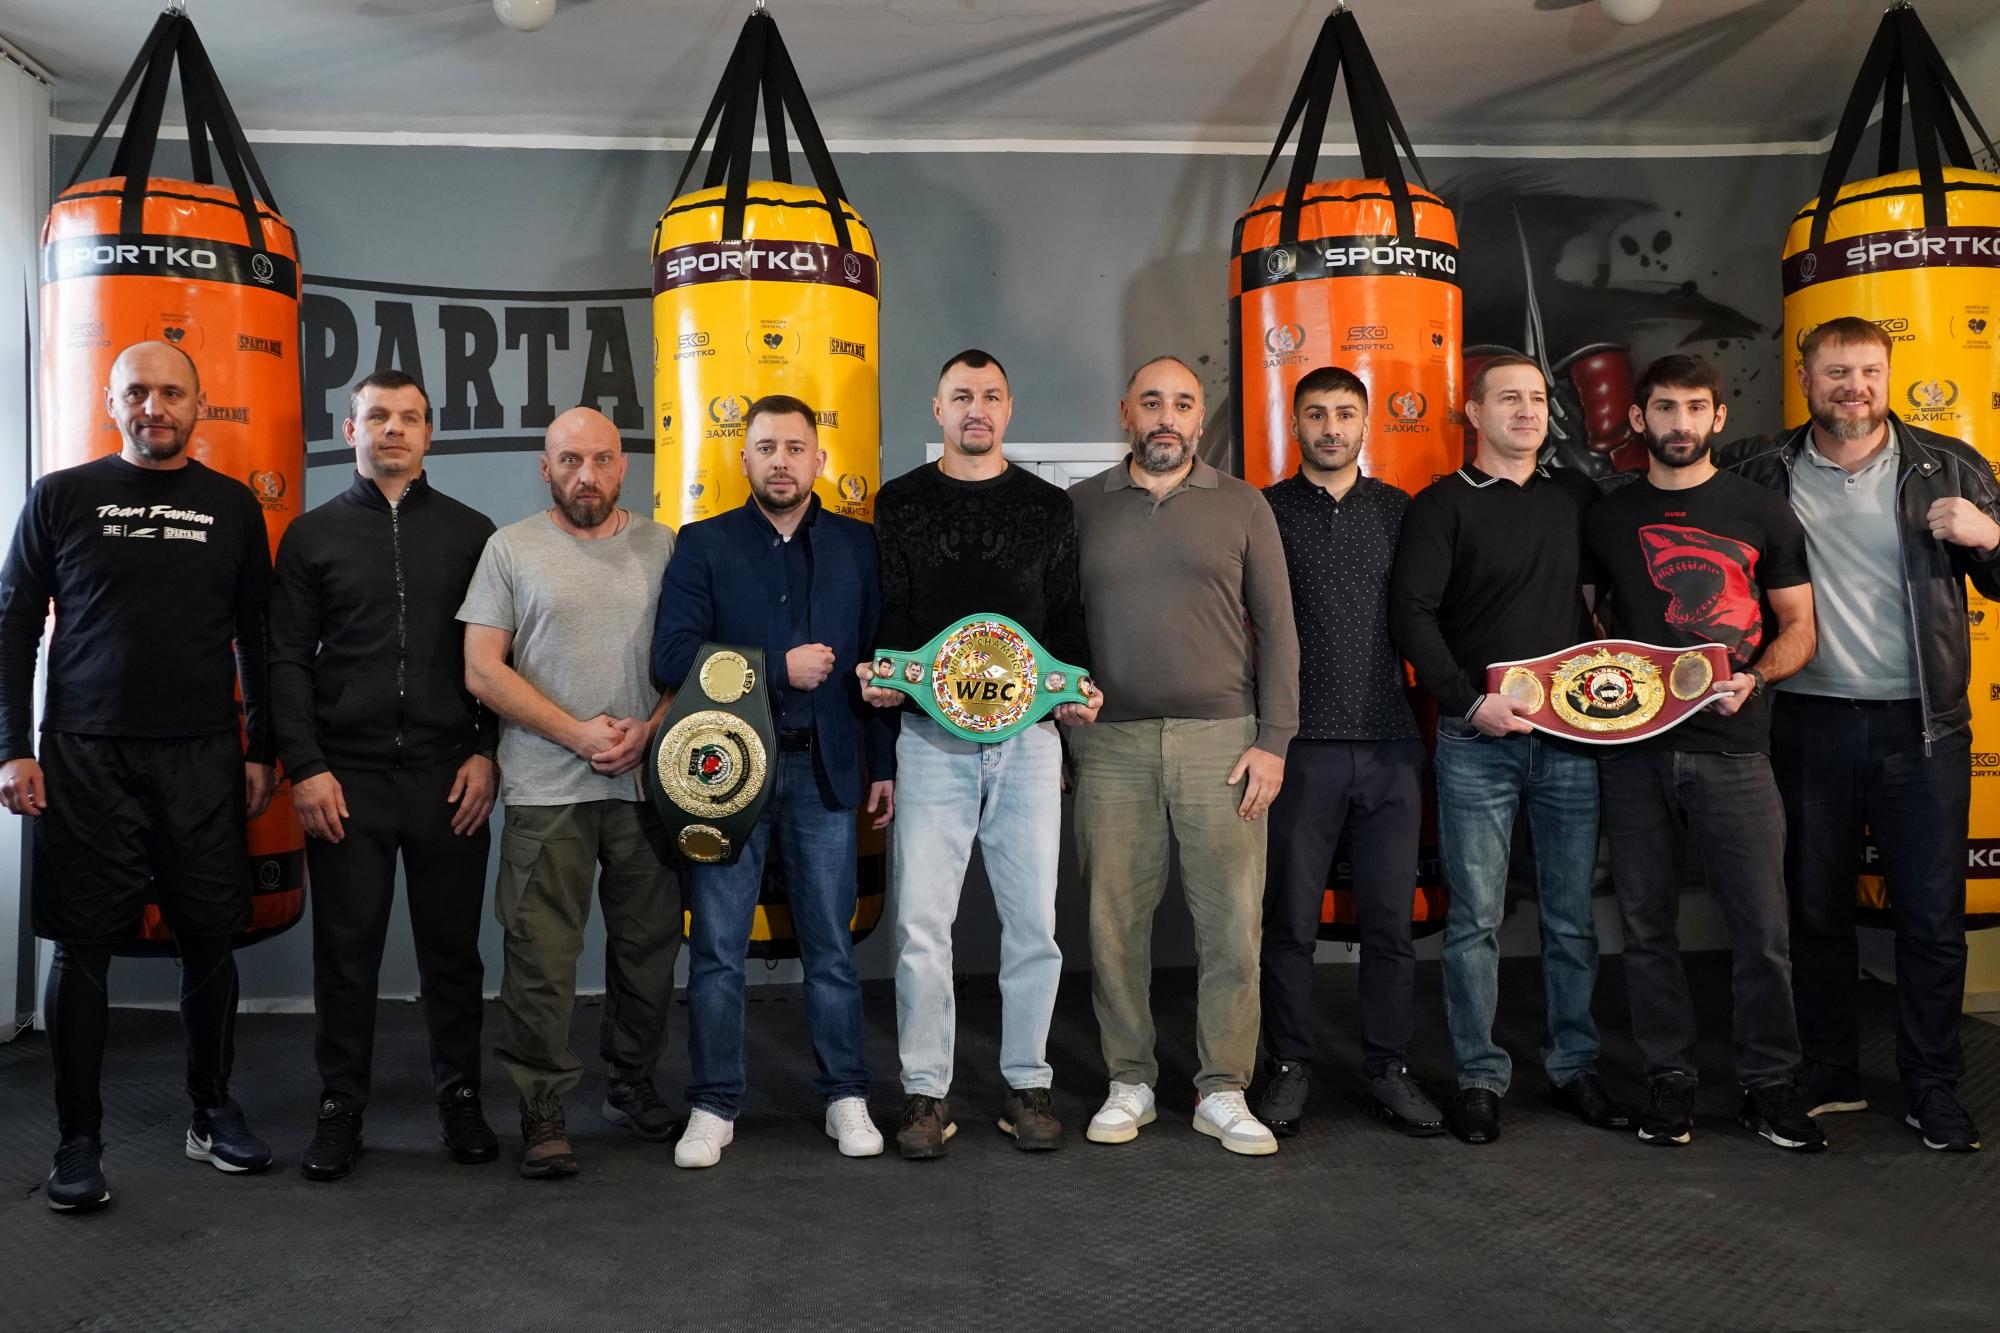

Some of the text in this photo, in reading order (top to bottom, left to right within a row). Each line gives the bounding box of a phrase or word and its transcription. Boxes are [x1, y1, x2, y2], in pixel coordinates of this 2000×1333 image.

[1846, 237, 2000, 266] SPORTK
[666, 250, 815, 280] SPORTKO
[1324, 246, 1457, 275] SPORTKO
[1873, 317, 1909, 332] KO
[1346, 325, 1389, 341] SKO
[240, 335, 270, 352] SPARTA
[831, 338, 855, 354] SPARTA
[1340, 343, 1395, 352] SPORTKO
[673, 348, 716, 361] SPORTKO
[301, 293, 645, 441] PARTA
[208, 406, 231, 419] ARTA
[822, 411, 837, 426] BOX
[1903, 411, 1963, 423] ЗАХИСТ+
[705, 428, 748, 439] ЗАХИС
[1383, 424, 1430, 434] ЗАХИСТ+
[96, 504, 146, 519] Team
[956, 680, 1016, 701] WBC
